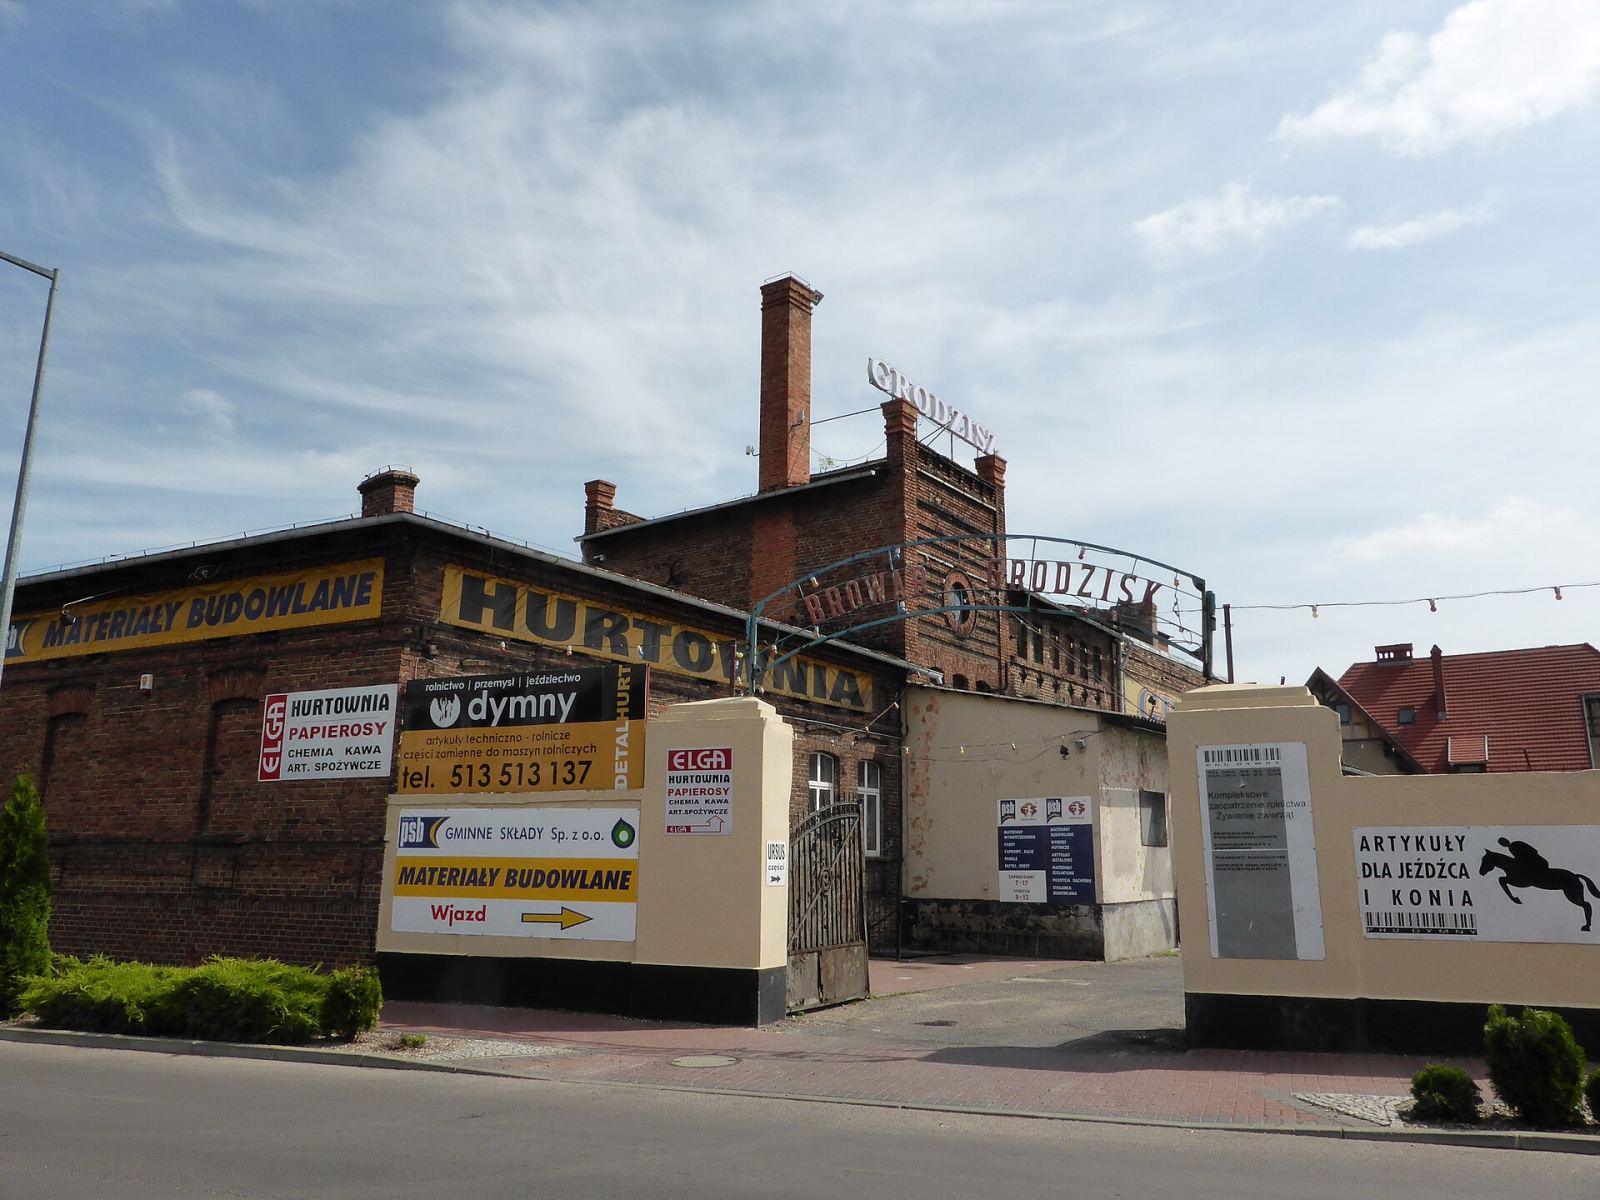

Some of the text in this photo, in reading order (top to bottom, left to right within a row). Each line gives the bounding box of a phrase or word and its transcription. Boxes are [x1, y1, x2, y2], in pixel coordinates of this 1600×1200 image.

[804, 557, 1162, 625] BROWAR GRODZISK
[42, 602, 183, 648] MATERIAŁY
[187, 573, 375, 627] BUDOWLANE
[459, 573, 866, 708] HURTOWNIA
[425, 673, 581, 692] rolnictwo przemysł jeździectwo
[291, 693, 390, 717] HURTOWNIA
[467, 690, 577, 727] dymny
[289, 722, 387, 740] PAPIEROSY
[615, 665, 631, 790] DETAL HURT
[263, 702, 285, 773] ELGA
[426, 730, 571, 746] artykuły techniczno rolnicze
[288, 745, 381, 758] CHEMIA KAWA
[404, 743, 597, 761] części zamienne do maszyn rolniczych
[673, 750, 726, 769] ELGA
[287, 760, 381, 773] ART. SPOŻYWCZE
[402, 760, 593, 788] tel. 513 513 137
[668, 774, 730, 784] HURTOWNIA
[668, 787, 730, 796] PAPIEROSY
[1208, 792, 1268, 800] Kompleksowe
[1208, 800, 1307, 811] zaopatrzenie rolnictwa
[1215, 810, 1294, 821] Żywienie zwierząt
[400, 817, 424, 847] psb
[445, 827, 604, 842] GMINNE SKŁADY Sp. z o.o.
[767, 843, 785, 860] URSUS
[1360, 835, 1466, 852] ARTYKUŁY
[768, 864, 785, 872] części
[1362, 858, 1470, 879] DLA JEŹDŹCA
[398, 866, 632, 890] MATERIAŁY BUDOWLANE
[1364, 889, 1473, 907] I KONIA
[431, 905, 487, 926] Wjazd
